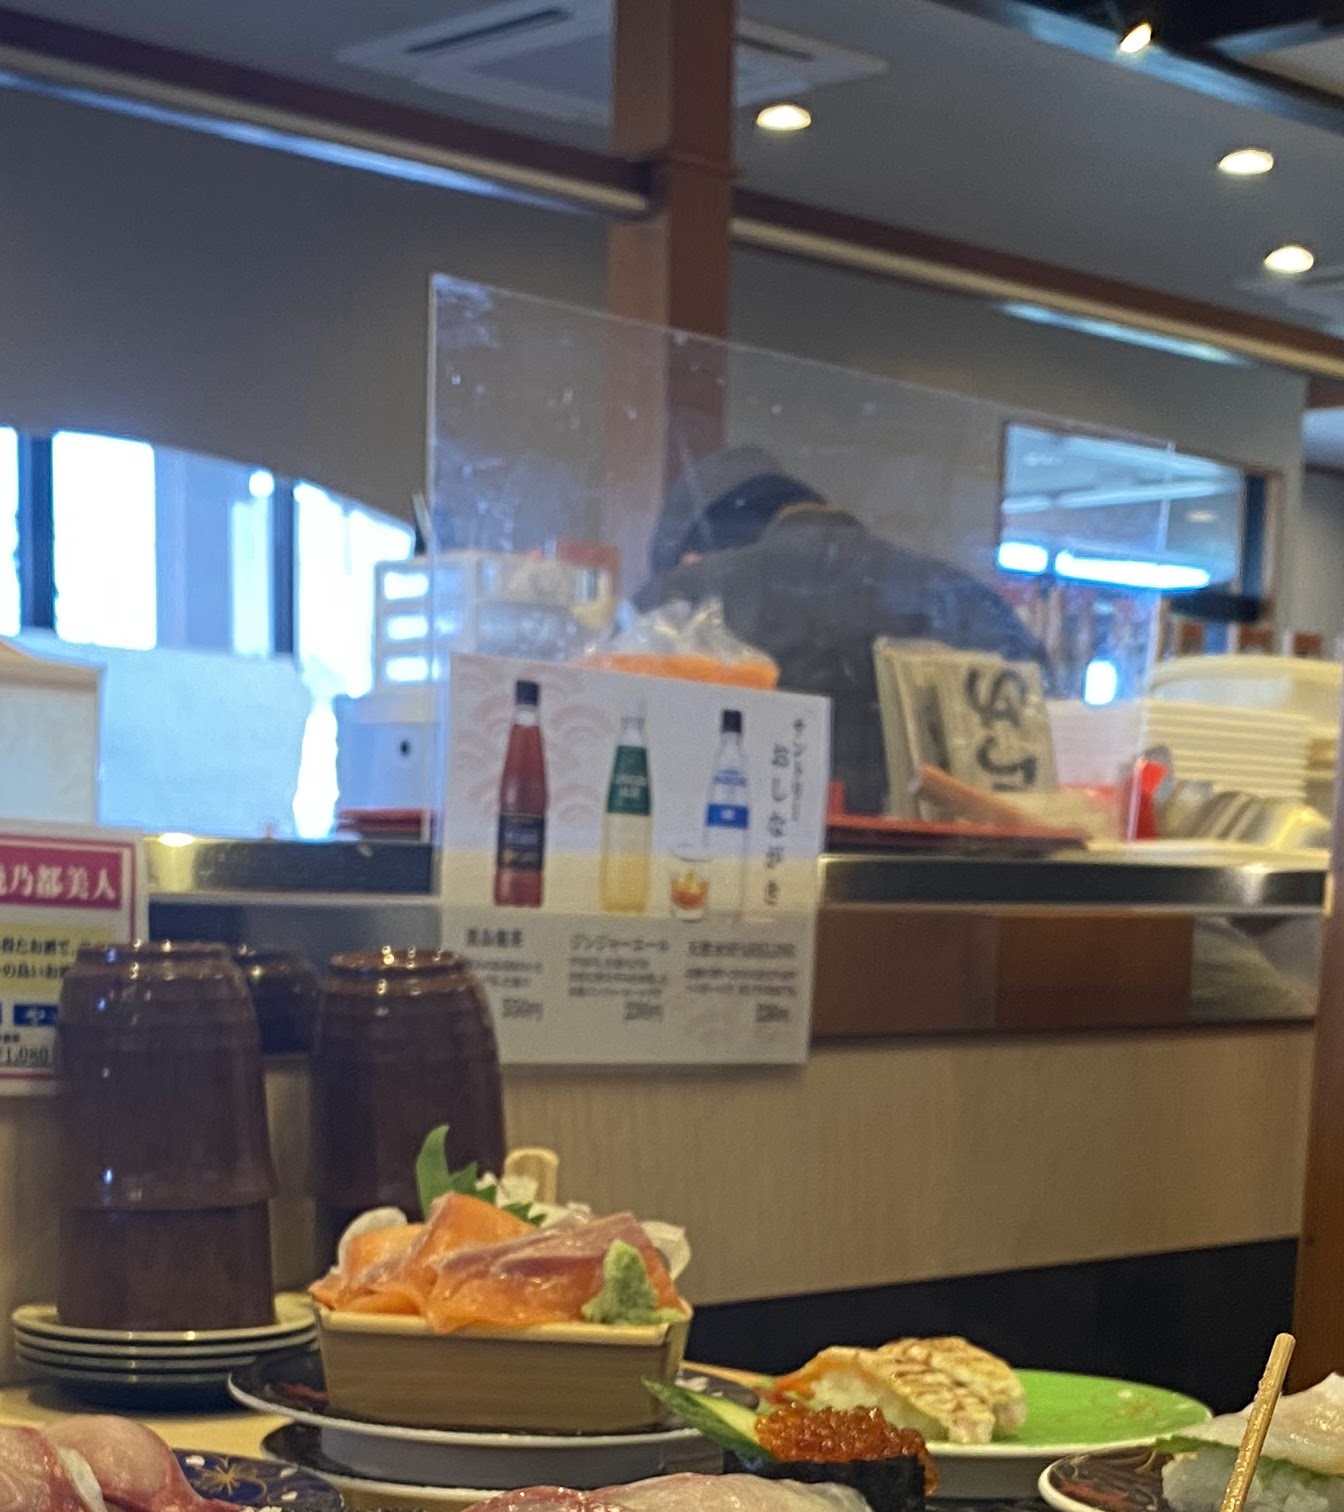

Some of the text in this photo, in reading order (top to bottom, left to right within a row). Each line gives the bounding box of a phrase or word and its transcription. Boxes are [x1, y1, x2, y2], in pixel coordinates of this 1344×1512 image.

[762, 742, 790, 906] おしながき
